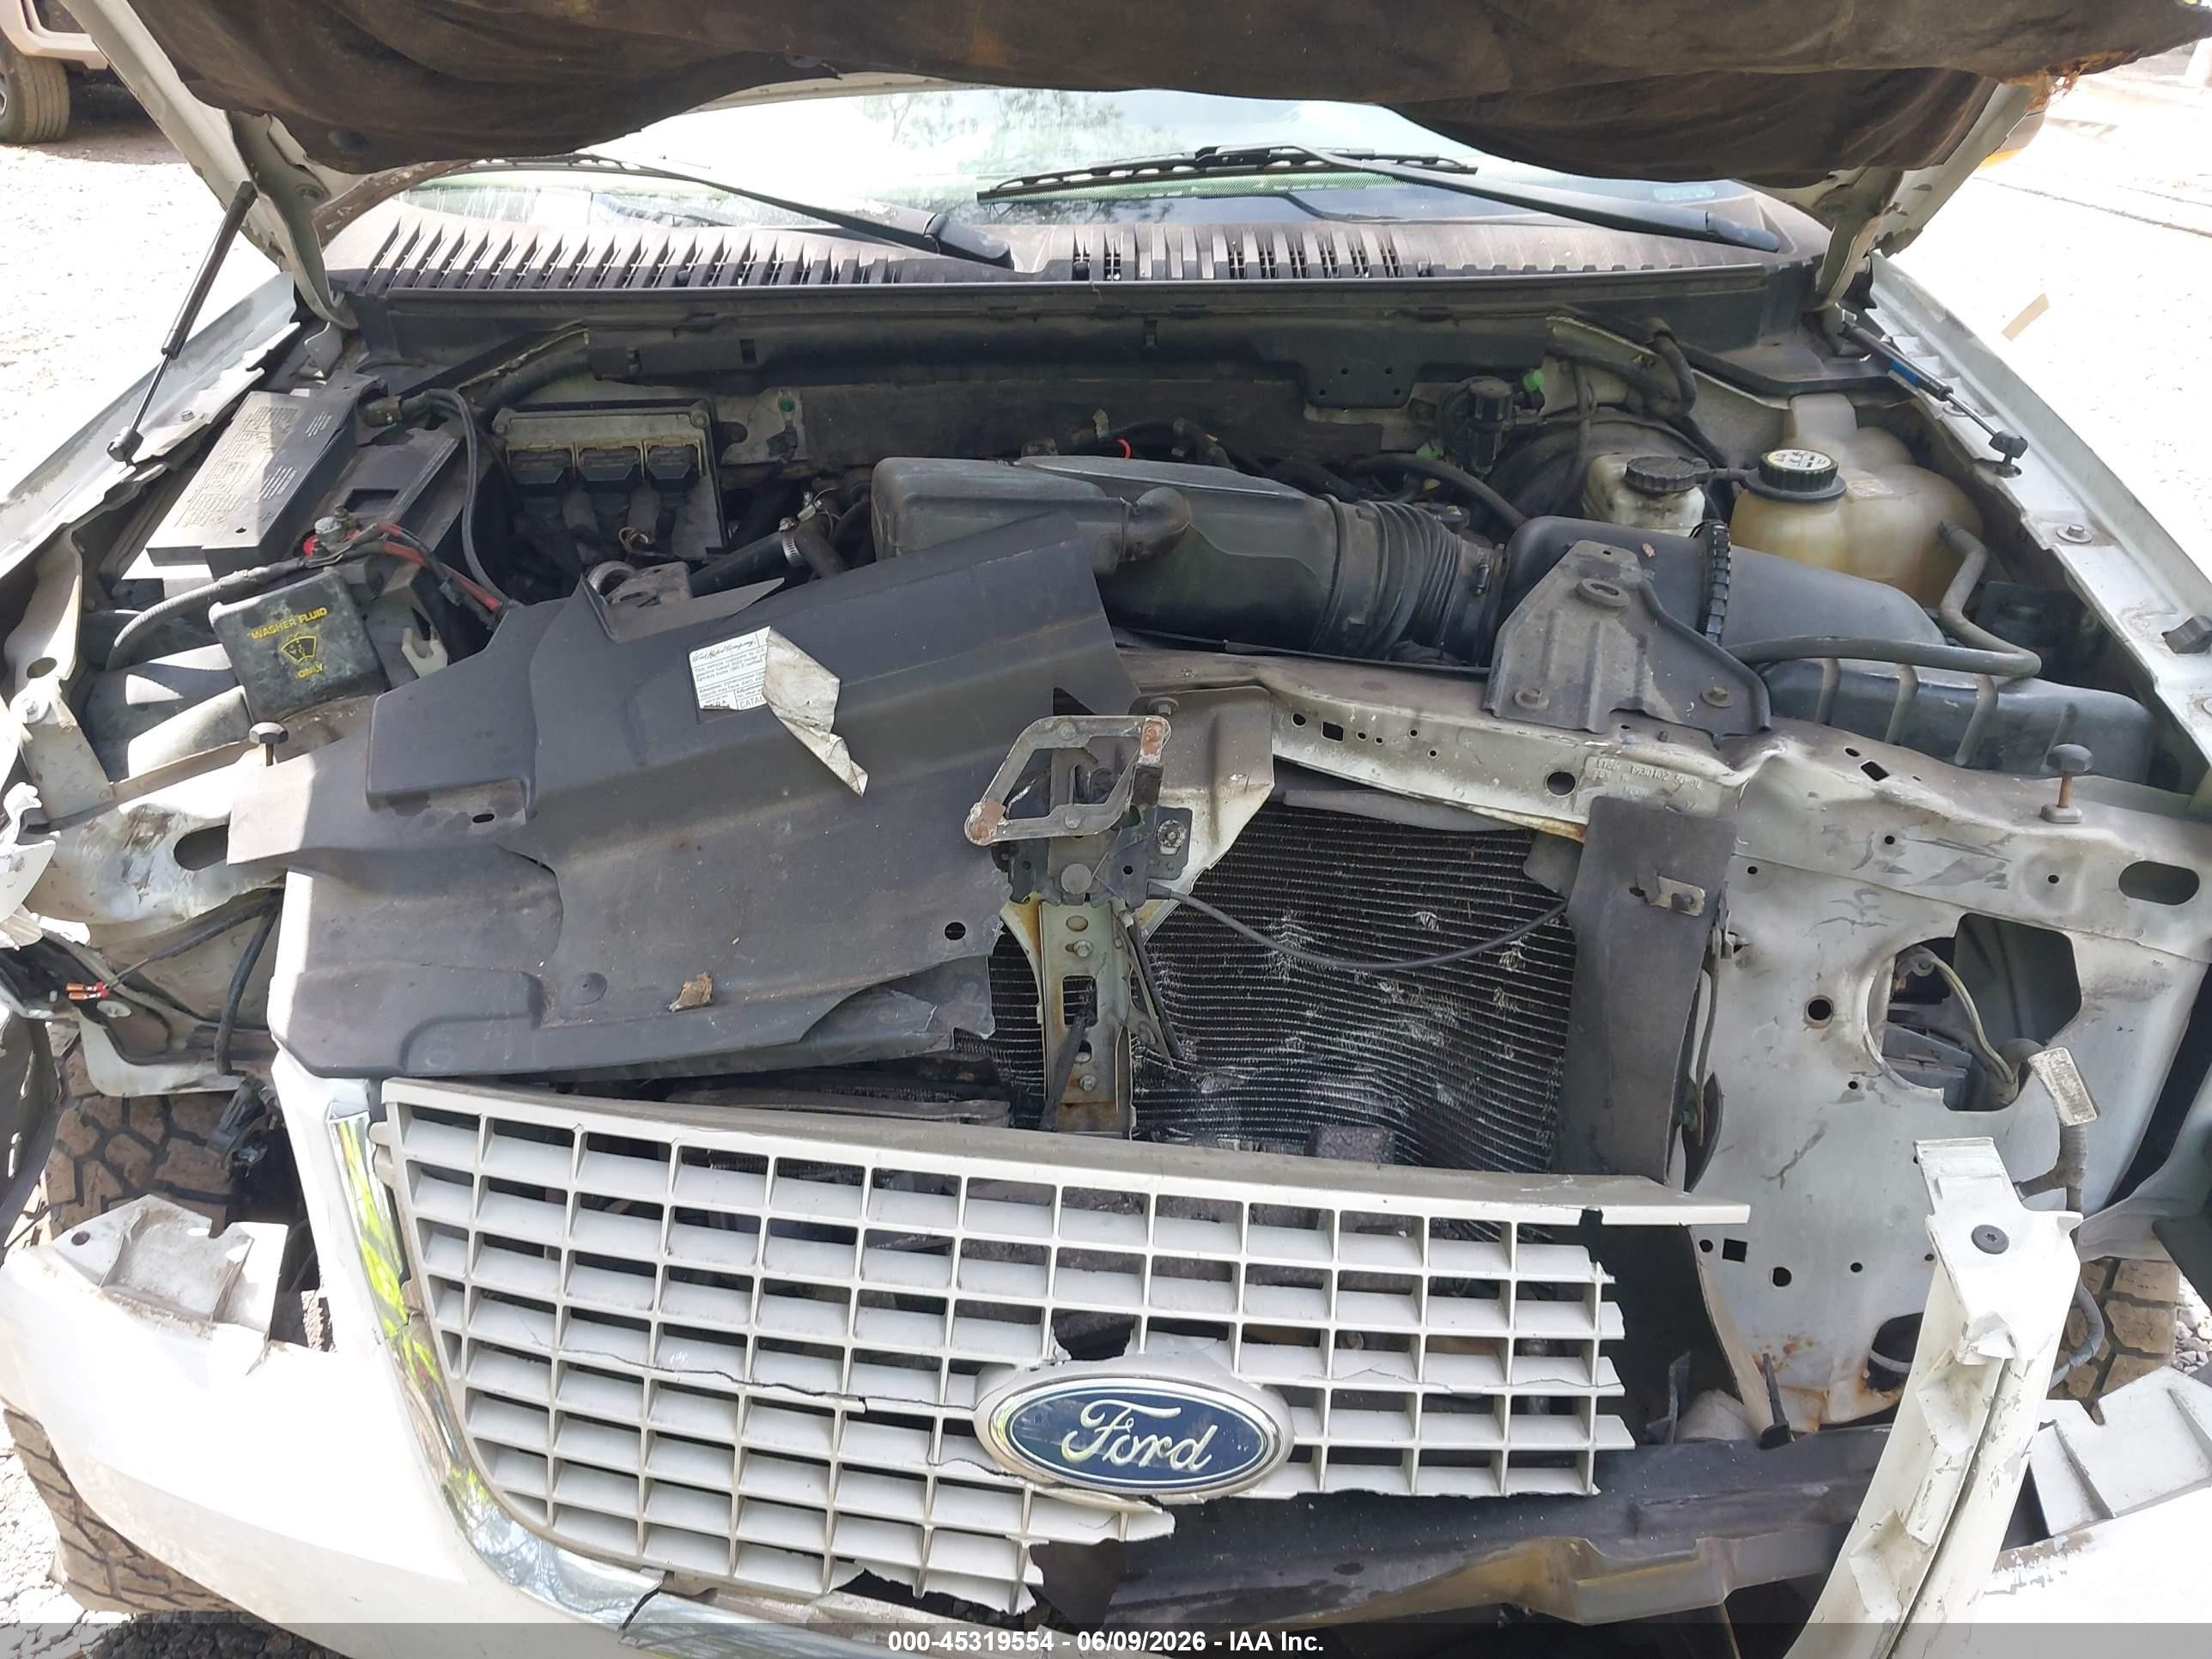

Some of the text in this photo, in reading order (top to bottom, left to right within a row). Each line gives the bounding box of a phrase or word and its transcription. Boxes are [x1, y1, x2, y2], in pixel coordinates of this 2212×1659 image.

[250, 607, 328, 640] WASHER FLUID
[296, 663, 325, 679] ONLY
[1060, 1398, 1219, 1474] Ford
